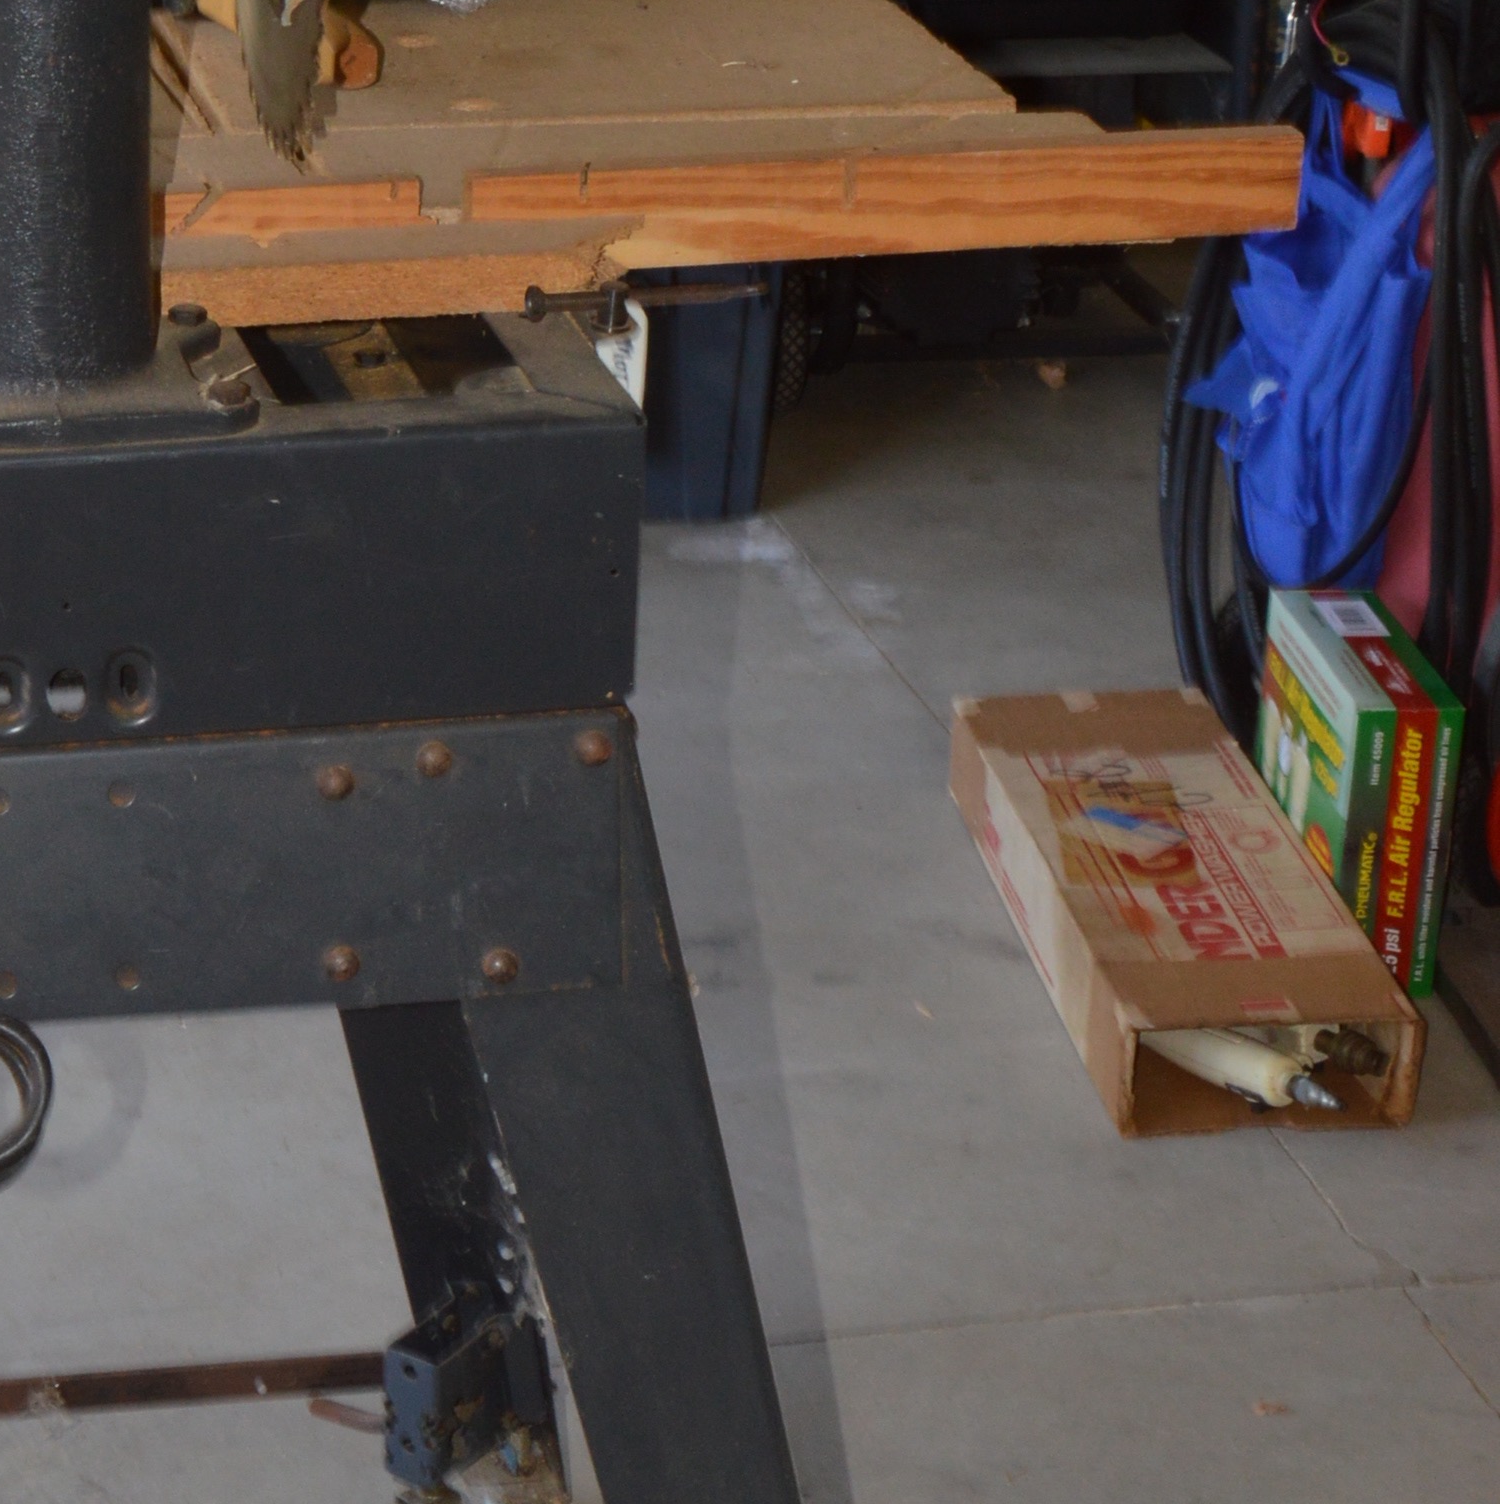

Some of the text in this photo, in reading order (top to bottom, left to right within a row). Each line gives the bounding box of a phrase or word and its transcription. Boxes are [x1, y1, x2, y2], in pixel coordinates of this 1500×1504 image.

[1369, 730, 1385, 785] Item 45009
[1392, 728, 1424, 831] Regulator
[1391, 834, 1412, 867] Air
[1216, 882, 1278, 947] POWER
[1385, 869, 1410, 919] F.R.L.
[1382, 927, 1402, 951] psi
